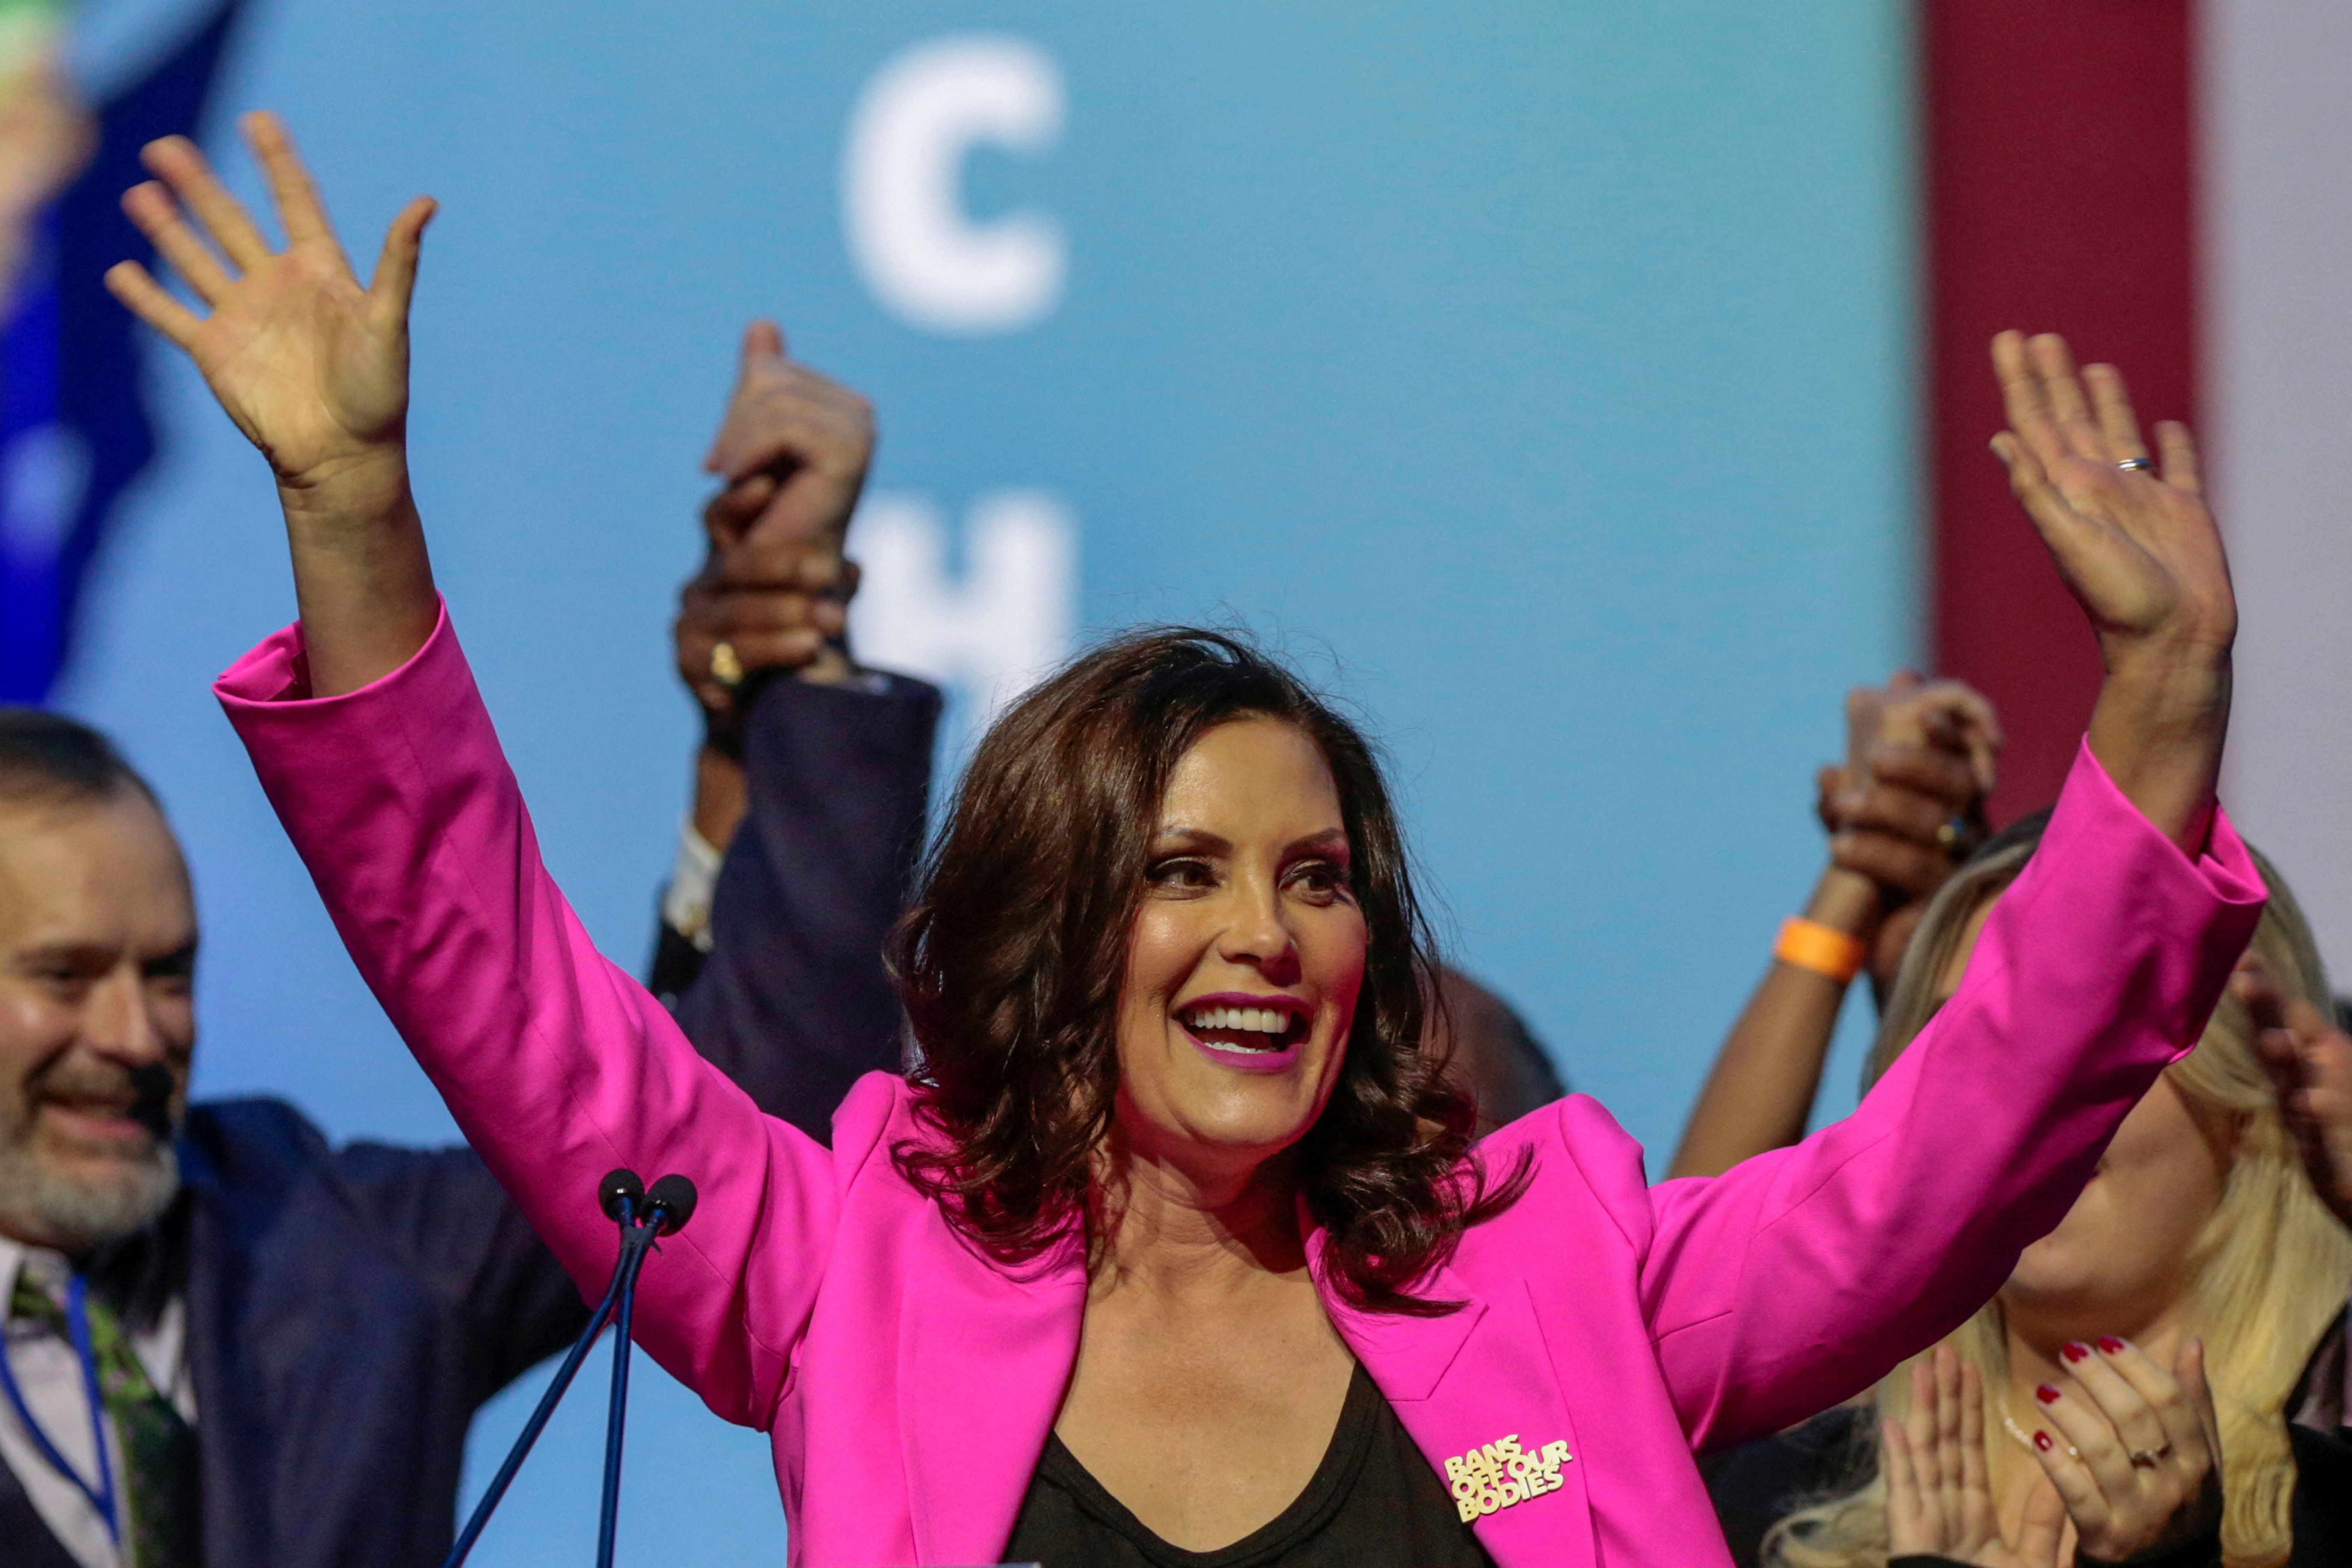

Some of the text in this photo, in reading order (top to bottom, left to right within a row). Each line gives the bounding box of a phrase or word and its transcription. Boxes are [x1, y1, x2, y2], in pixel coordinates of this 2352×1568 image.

[1444, 1434, 1522, 1481] BANS
[1452, 1440, 1573, 1500] OFF OUR
[1457, 1463, 1564, 1523] BODIES
